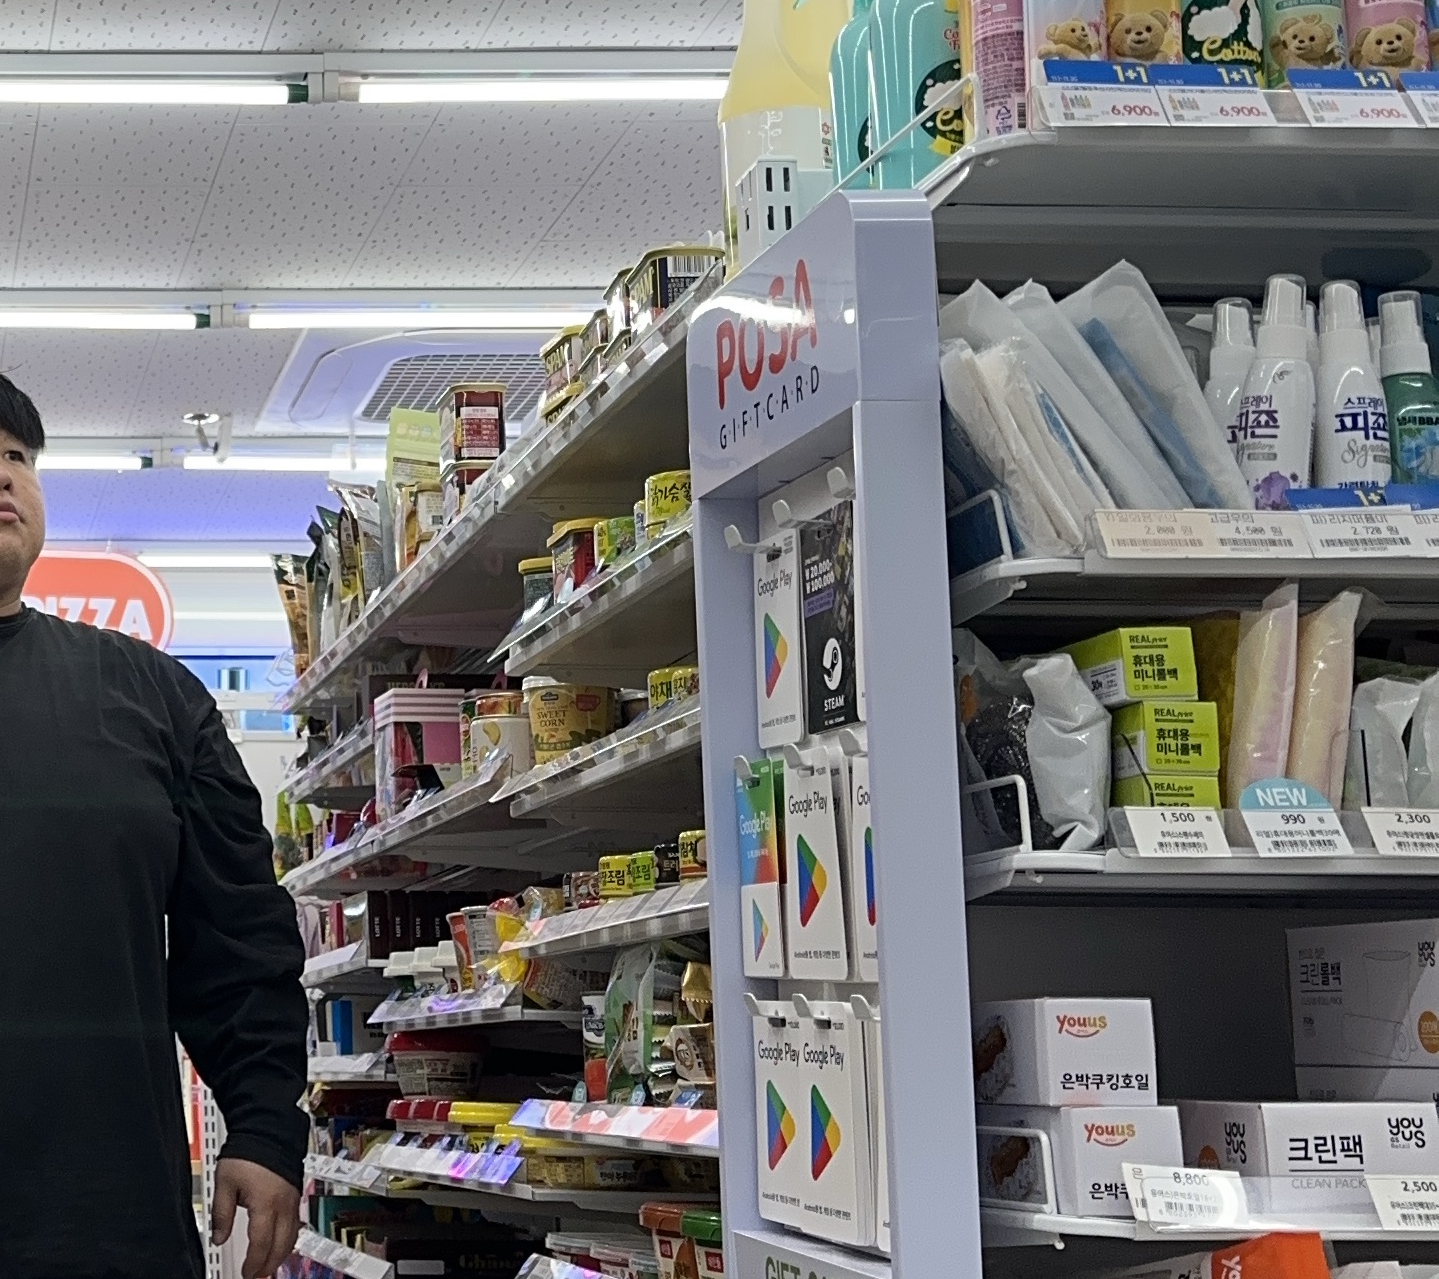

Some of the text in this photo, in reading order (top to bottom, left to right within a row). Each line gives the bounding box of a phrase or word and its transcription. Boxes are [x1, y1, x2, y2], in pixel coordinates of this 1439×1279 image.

[1113, 66, 1149, 84] 1+1
[1217, 67, 1257, 86] 1+1
[1353, 71, 1392, 88] 1+1
[1111, 104, 1153, 117] 6,900
[1219, 106, 1261, 118] 6,900
[1359, 107, 1402, 120] 6,900
[1334, 409, 1389, 442] 피죤
[757, 572, 780, 598] Google
[779, 569, 793, 589] Play
[1132, 654, 1166, 667] 휴대용
[1133, 666, 1179, 681] 미니롤백
[824, 694, 845, 713] STEAM
[1156, 728, 1190, 742] 휴대용
[1156, 742, 1202, 757] 미니롤백
[788, 791, 828, 818] Google Play
[1254, 787, 1309, 808] NEW
[1160, 812, 1196, 824] 1,500
[1281, 814, 1306, 825] 990
[1394, 812, 1432, 825] 2,300
[1055, 1012, 1109, 1035] youus
[758, 1040, 801, 1068] Google Play
[803, 1042, 846, 1072] Google Play
[1060, 1072, 1150, 1092] 은박쿠킹호일
[1084, 1123, 1137, 1144] youus
[1288, 1133, 1365, 1166] 크린팩
[1173, 1171, 1210, 1187] 8,800
[1292, 1178, 1368, 1190] CLEAN PACK
[1402, 1180, 1438, 1194] 2,500
